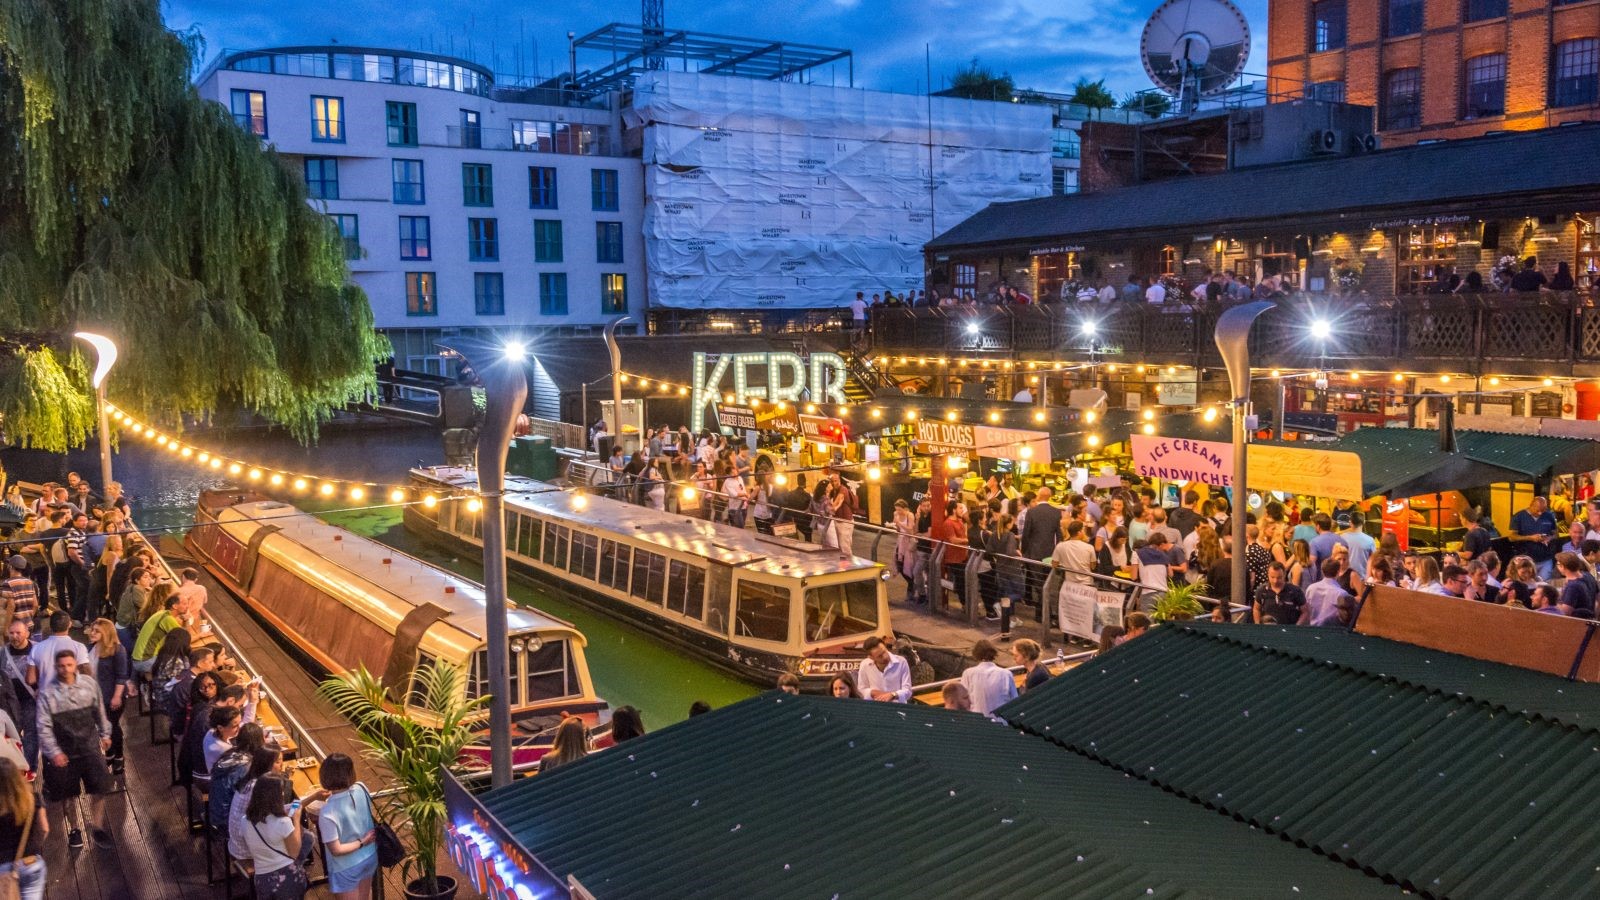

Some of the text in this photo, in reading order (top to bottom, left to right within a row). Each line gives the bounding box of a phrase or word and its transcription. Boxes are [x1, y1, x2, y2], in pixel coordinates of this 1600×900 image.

[1435, 214, 1470, 223] Kitchen
[918, 421, 973, 446] HOT DOGS
[928, 444, 939, 454] OH
[1149, 439, 1222, 469] ICE CREAM
[822, 662, 861, 672] GARDE
